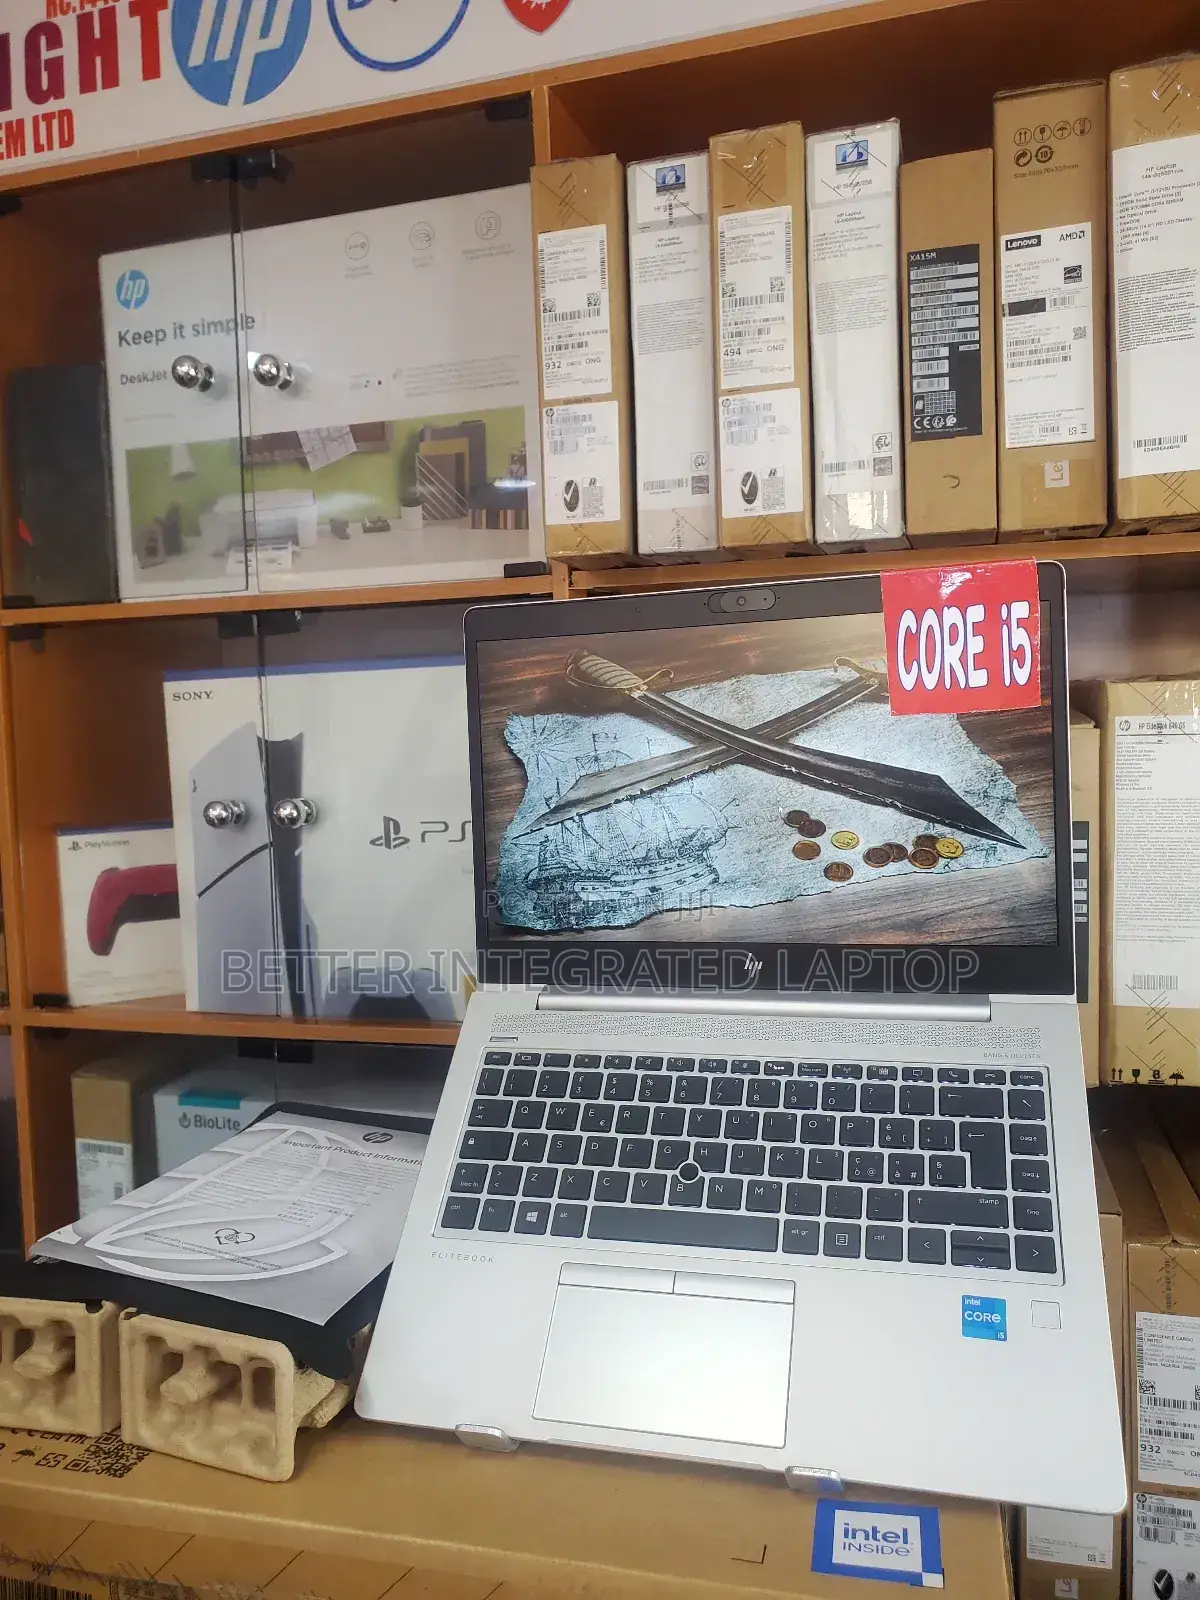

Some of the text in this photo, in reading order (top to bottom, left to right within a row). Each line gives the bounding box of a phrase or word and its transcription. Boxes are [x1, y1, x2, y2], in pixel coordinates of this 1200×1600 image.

[0, 108, 75, 161] M LTD
[1156, 163, 1177, 171] Laptop
[1059, 231, 1077, 242] AMD
[1008, 238, 1038, 249] Lenovo
[910, 251, 937, 262] X415M
[116, 269, 150, 310] hp
[118, 312, 256, 347] Keep it simple
[723, 344, 784, 357] 494 ONG
[545, 357, 602, 370] 932 ONG
[120, 370, 168, 386] DeskJet
[897, 600, 1032, 692] CORE i5
[172, 690, 213, 702] SONY
[420, 820, 472, 843] PS
[521, 1106, 529, 1114] Q
[555, 1107, 566, 1115] W
[623, 1111, 631, 1119] R
[660, 1112, 666, 1120] T
[696, 1114, 704, 1122] Y
[194, 1113, 241, 1131] BioLite
[732, 1116, 740, 1124] U
[808, 1120, 817, 1128] O
[847, 1122, 854, 1130] P
[521, 1138, 529, 1147] A
[556, 1140, 563, 1148] S
[591, 1142, 599, 1150] D
[282, 1139, 423, 1165] Important Product Informati
[626, 1144, 634, 1152] F
[664, 1146, 672, 1154] G
[700, 1148, 708, 1156] H
[776, 1153, 784, 1161] K
[531, 1173, 539, 1181] Z
[566, 1175, 575, 1183] X
[603, 1178, 610, 1186] C
[640, 1179, 648, 1187] V
[676, 1184, 684, 1192] B
[715, 1185, 723, 1193] N
[754, 1187, 763, 1195] M
[1026, 1208, 1040, 1216] fine
[431, 1251, 494, 1263] ELITEBOOK
[964, 1298, 981, 1306] intel
[997, 1331, 1005, 1339] i5
[1140, 1443, 1161, 1454] 932
[843, 1522, 909, 1545] intel
